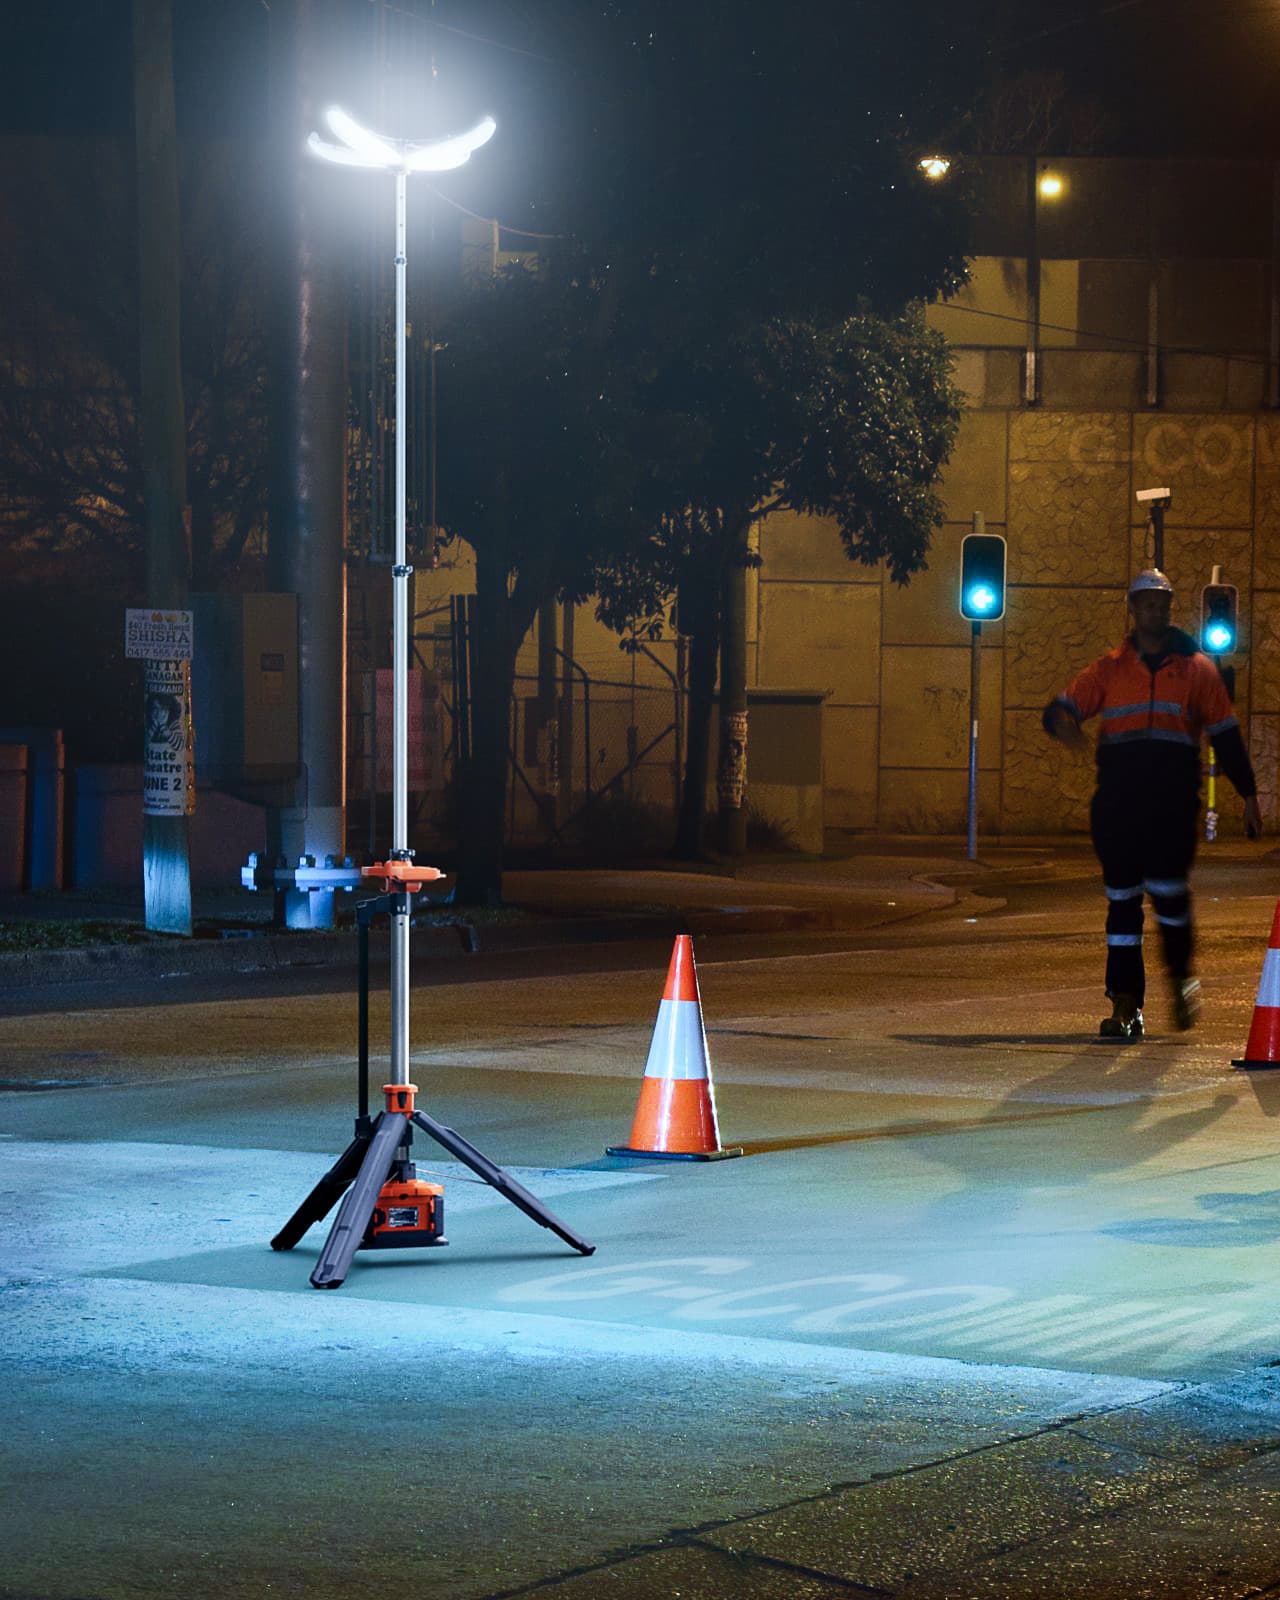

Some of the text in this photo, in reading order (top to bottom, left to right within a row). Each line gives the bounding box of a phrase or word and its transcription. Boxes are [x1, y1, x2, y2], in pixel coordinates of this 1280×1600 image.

[128, 630, 190, 643] SHISHA
[145, 671, 183, 681] ANAGAN
[173, 777, 182, 791] 2
